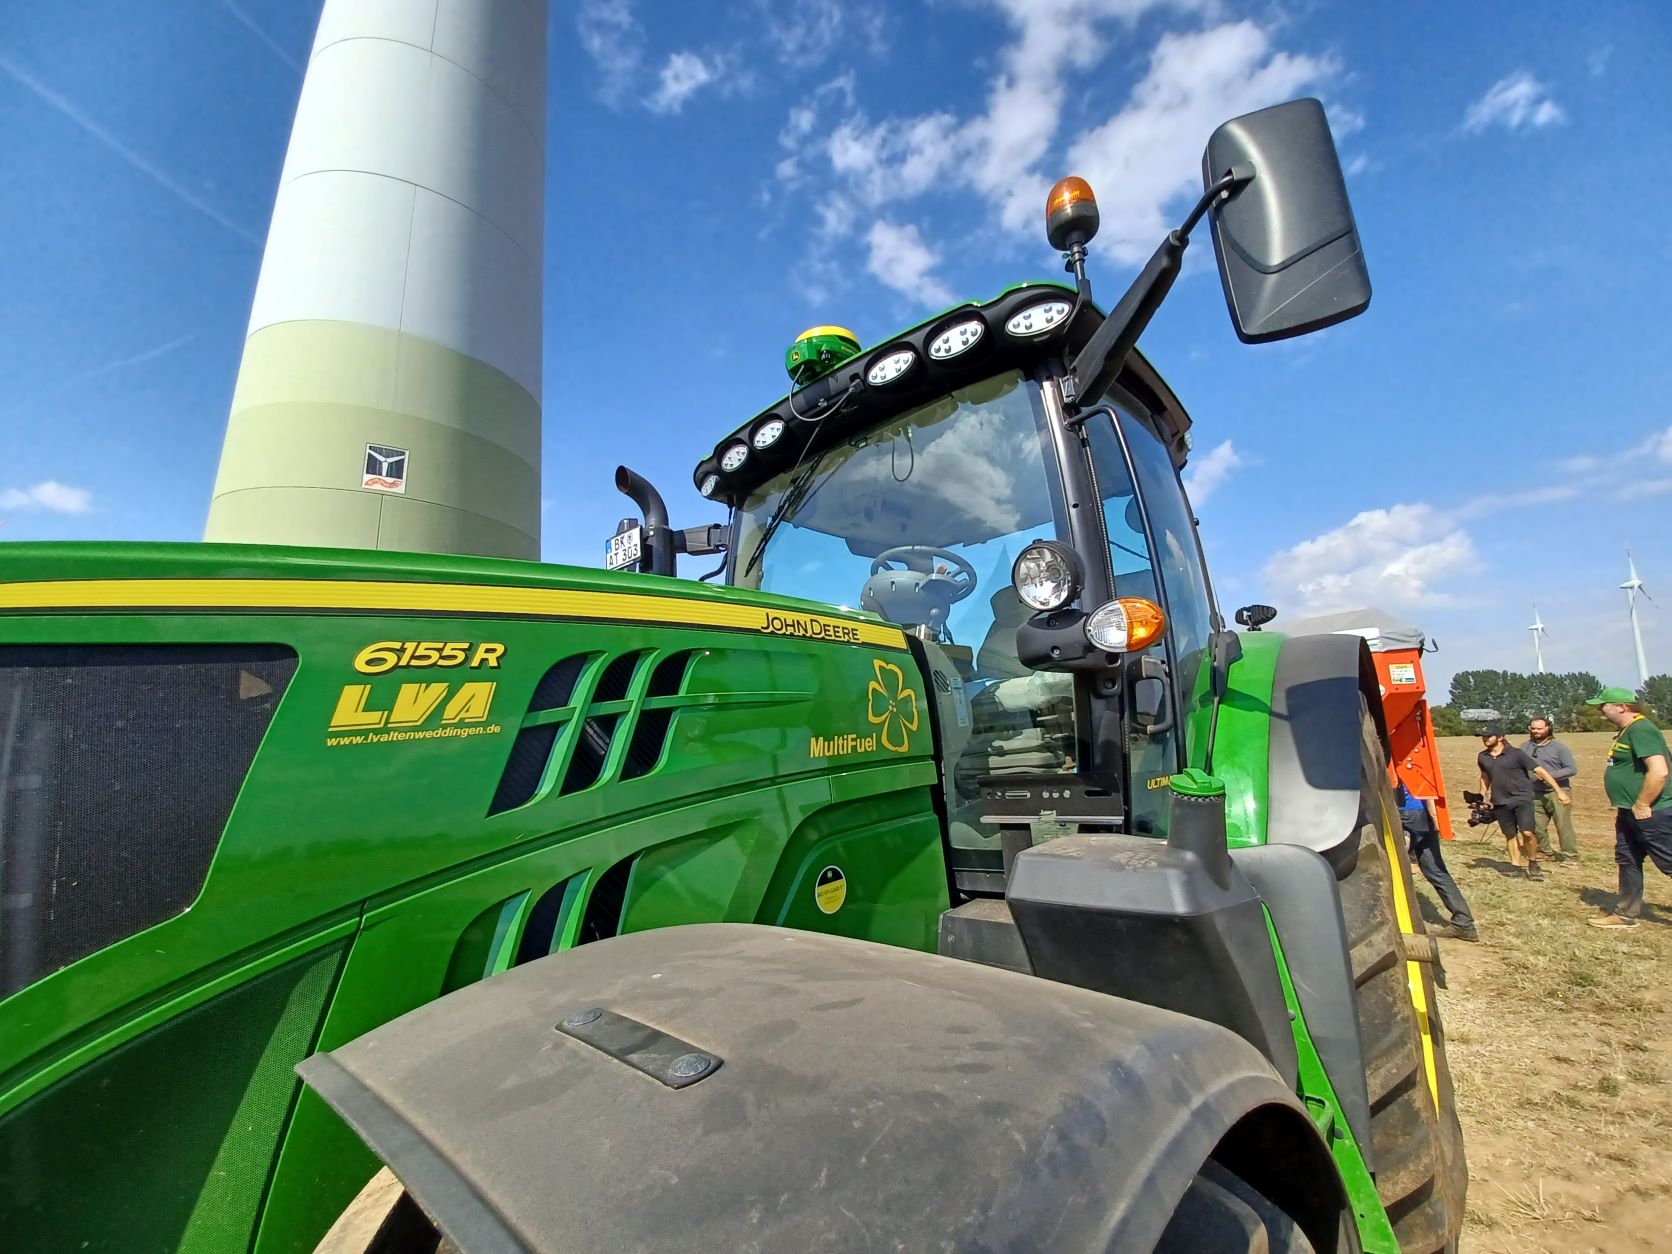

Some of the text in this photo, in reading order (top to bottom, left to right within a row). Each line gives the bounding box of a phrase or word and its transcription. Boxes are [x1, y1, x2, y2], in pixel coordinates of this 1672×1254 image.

[609, 543, 639, 566] AT 303
[614, 535, 626, 551] BK
[760, 612, 861, 642] JOHN DEERE
[353, 640, 507, 675] 6155 R
[327, 681, 497, 732] LVA
[326, 724, 502, 747] www.lvaltenweddingen.de
[808, 732, 877, 759] MultiFuel
[1147, 775, 1170, 789] ULTIM
